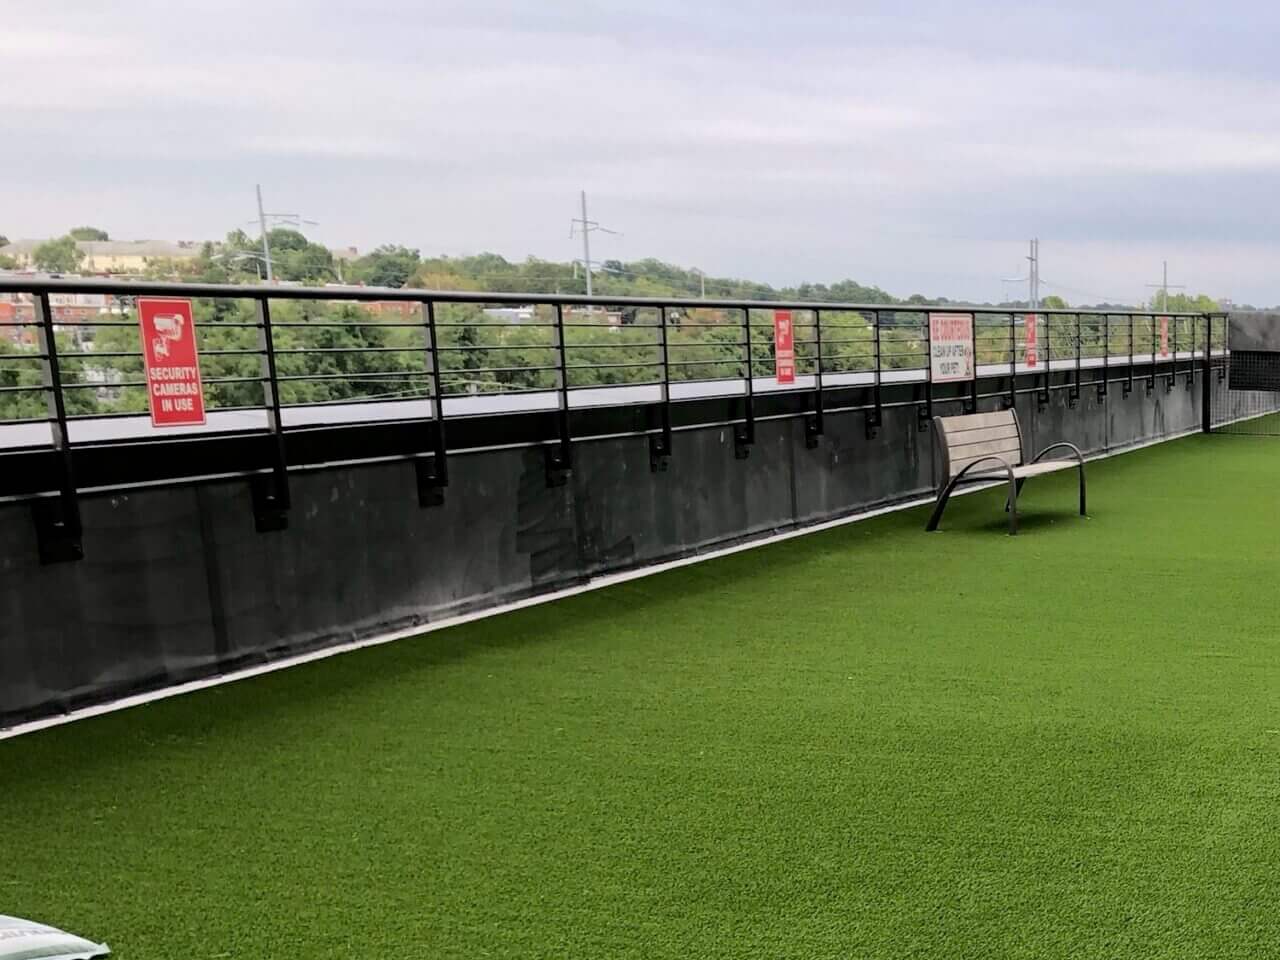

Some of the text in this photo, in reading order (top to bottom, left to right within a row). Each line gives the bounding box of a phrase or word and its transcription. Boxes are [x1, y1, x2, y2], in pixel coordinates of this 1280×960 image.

[150, 367, 196, 380] SECURITY
[152, 383, 198, 396] CAMERAS
[161, 398, 194, 412] IN USE
